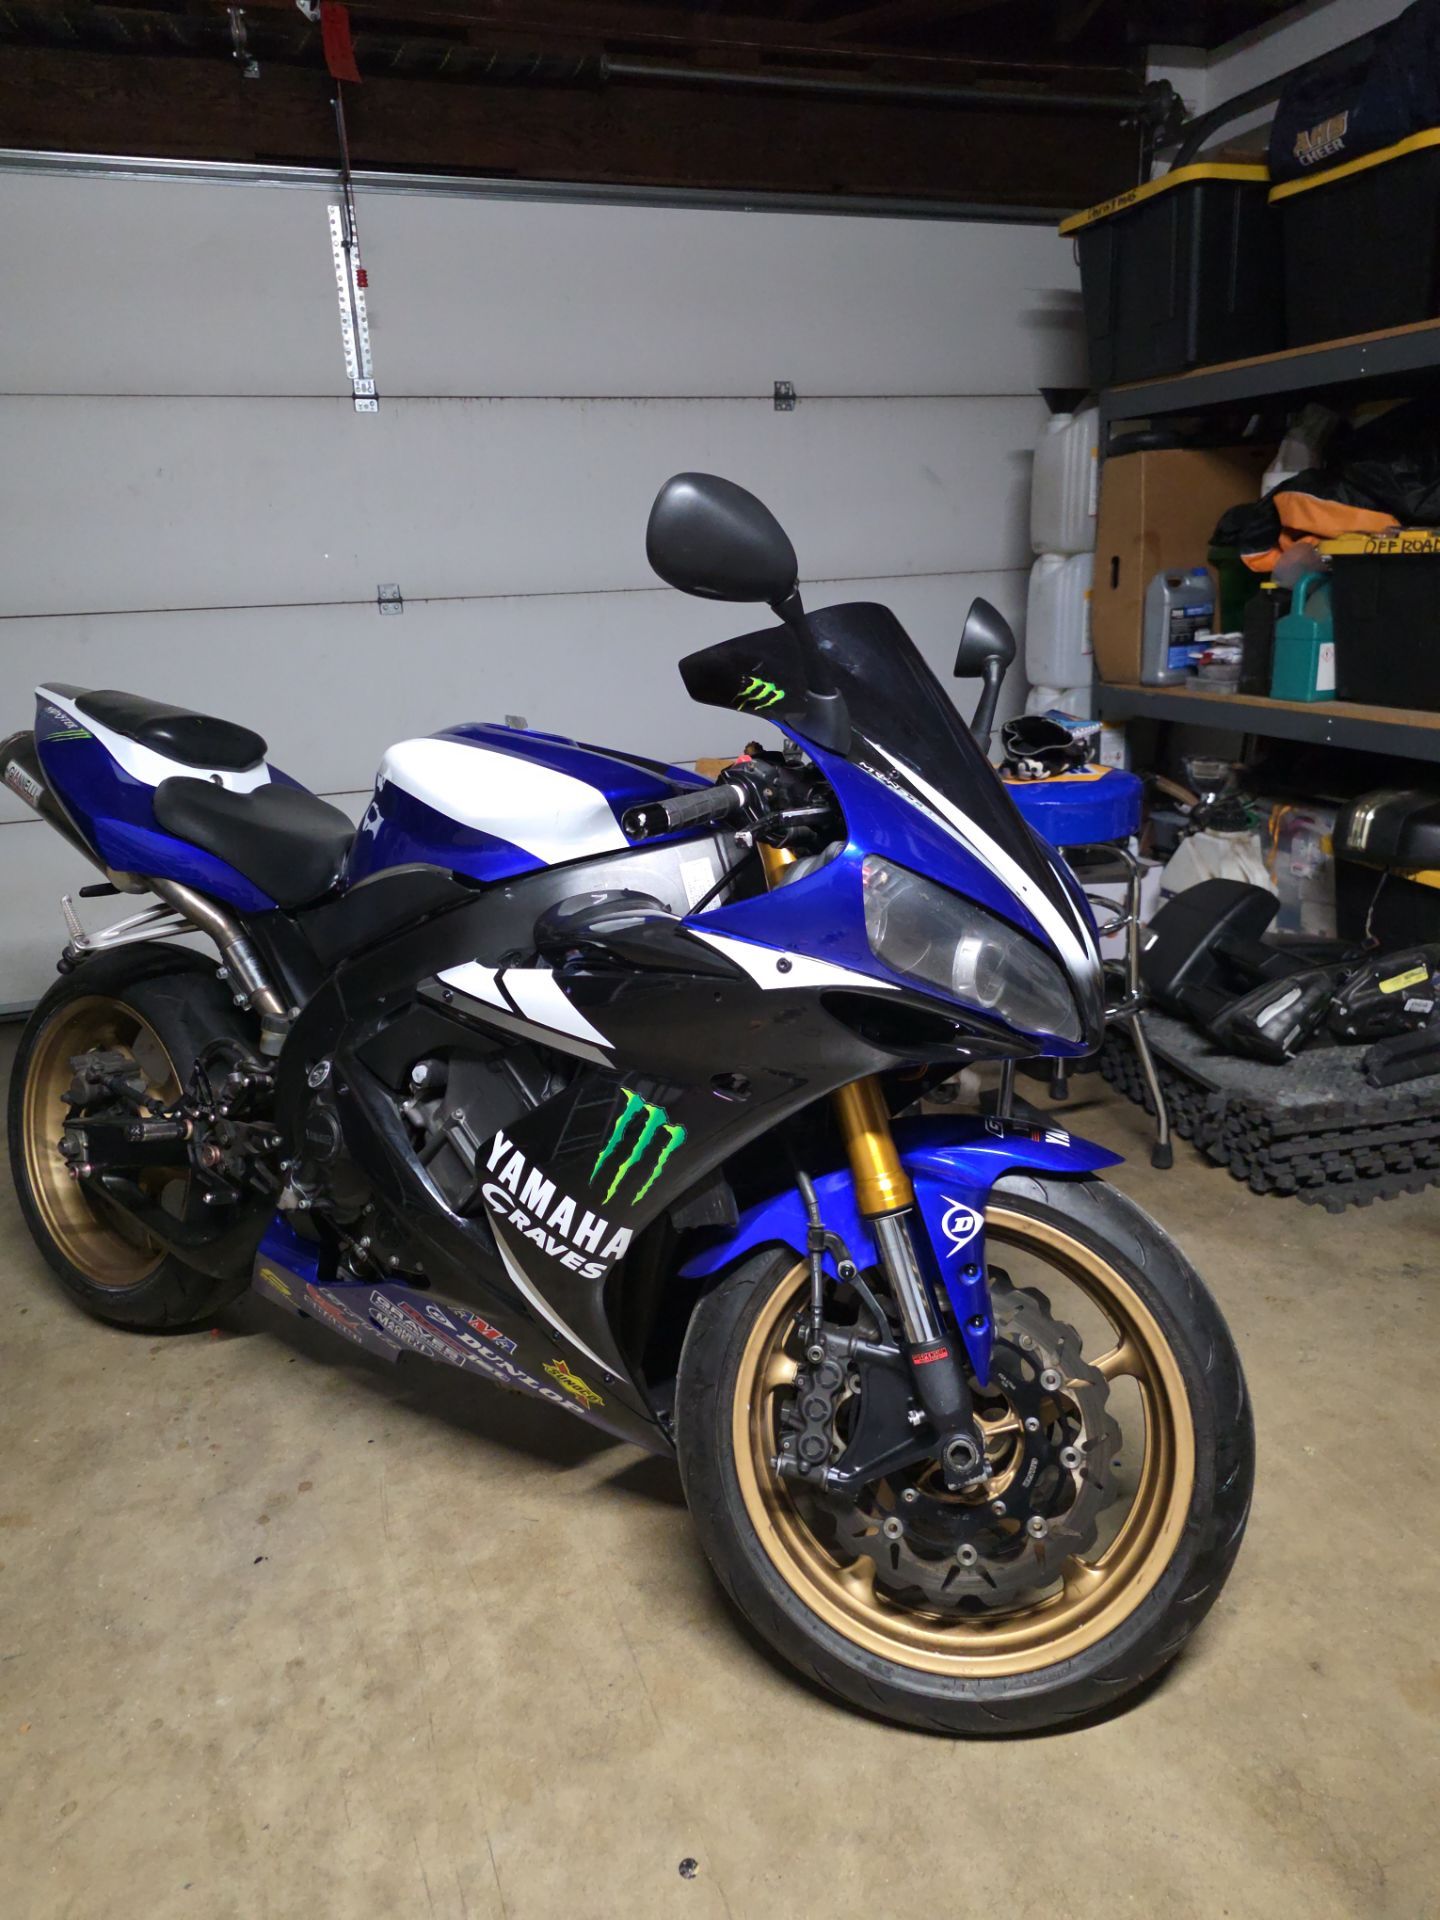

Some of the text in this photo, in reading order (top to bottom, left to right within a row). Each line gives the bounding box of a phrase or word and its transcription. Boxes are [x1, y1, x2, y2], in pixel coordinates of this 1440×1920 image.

[1299, 137, 1345, 167] CHEER
[1363, 539, 1398, 554] OFF
[486, 1130, 633, 1260] YAMAHA
[482, 1183, 607, 1279] GRAVES
[456, 1332, 585, 1414] DUNLOP
[551, 1368, 599, 1401] SUNOCO
